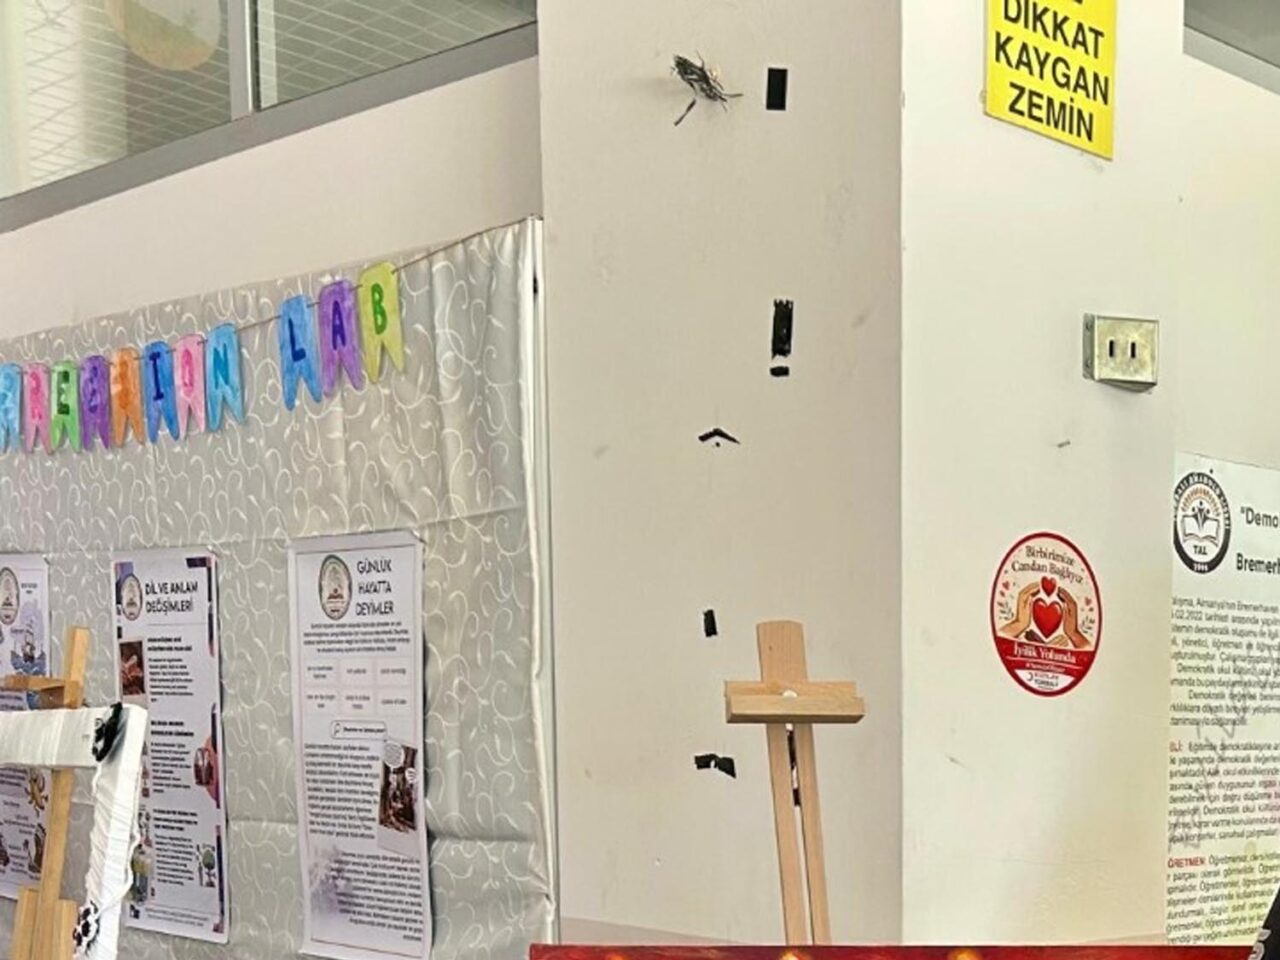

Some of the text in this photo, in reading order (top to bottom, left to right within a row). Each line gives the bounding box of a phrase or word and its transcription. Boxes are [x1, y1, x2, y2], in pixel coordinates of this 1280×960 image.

[995, 31, 1109, 106] KAYGAN
[1009, 81, 1093, 142] ZEMİN
[290, 281, 389, 363] LAB
[158, 582, 169, 594] VE
[170, 580, 198, 594] ANLAM
